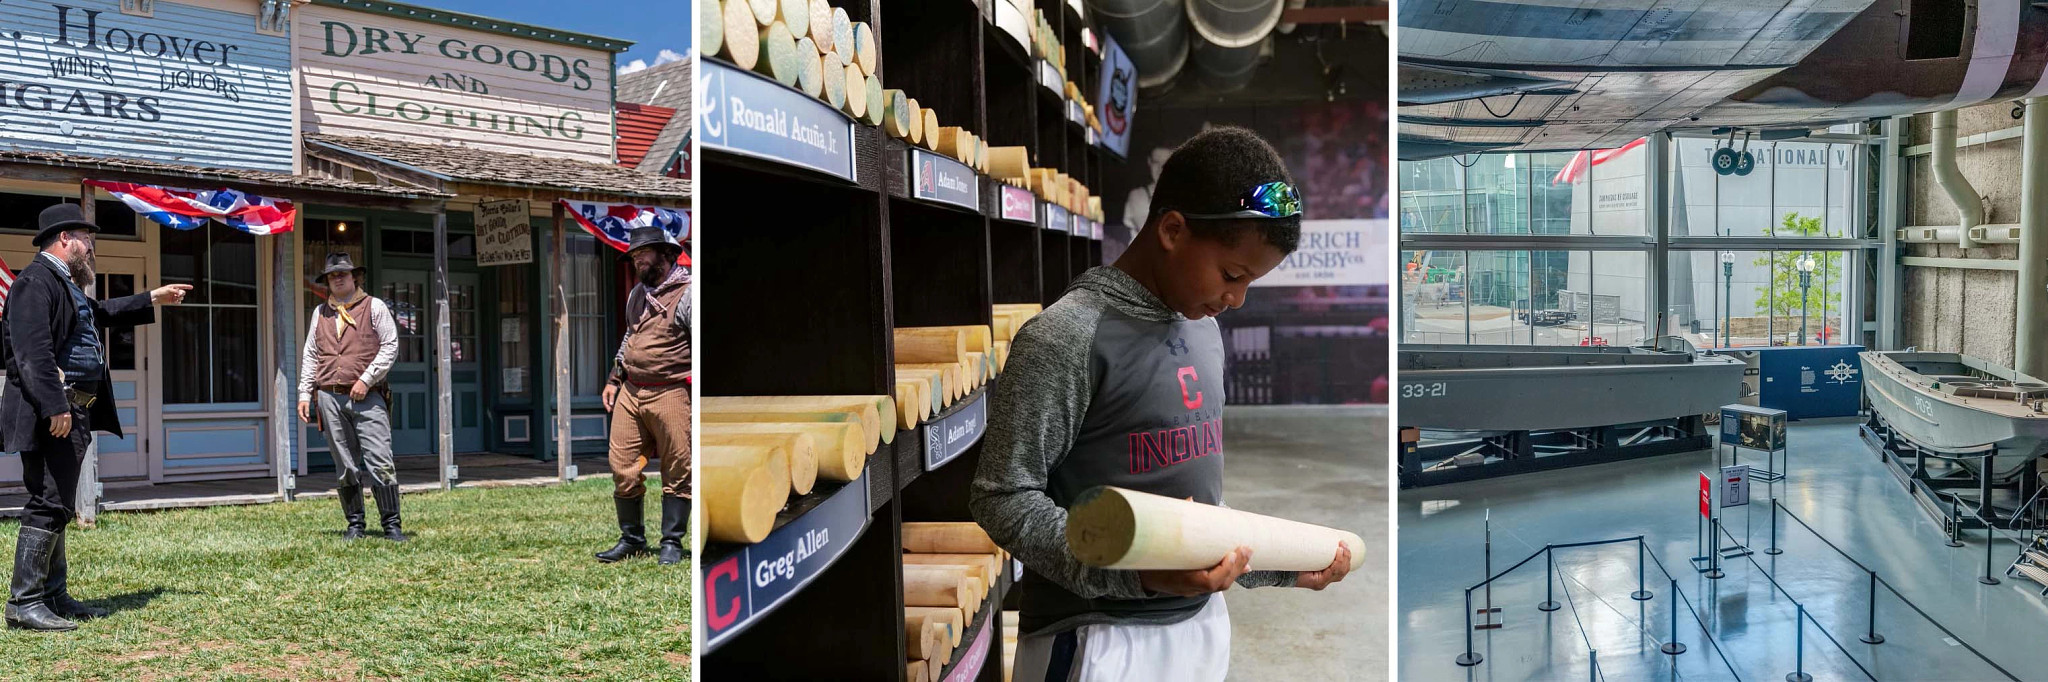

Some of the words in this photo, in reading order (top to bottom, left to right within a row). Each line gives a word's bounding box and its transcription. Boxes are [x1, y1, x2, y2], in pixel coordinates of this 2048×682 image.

[51, 4, 239, 68] Hoover
[50, 56, 114, 86] WINES
[320, 21, 426, 58] DRY
[438, 39, 592, 91] GOODS
[160, 70, 240, 103] LIQUORS
[424, 72, 489, 95] AND
[329, 81, 585, 140] CLOTHING
[731, 96, 788, 138] Ronald
[791, 116, 827, 155] Acuña,
[828, 130, 838, 155] Jr.
[1749, 148, 1826, 165] ATIONAL
[938, 171, 956, 190] Adam
[956, 176, 968, 194] Jones
[498, 223, 530, 245] CLOTHING
[1278, 251, 1347, 271] ADSBY
[1177, 366, 1203, 409] C
[1402, 382, 1447, 398] 33-21
[947, 425, 965, 444] Adam
[755, 550, 795, 588] Greg
[796, 527, 829, 564] Allen
[705, 556, 741, 631] C
